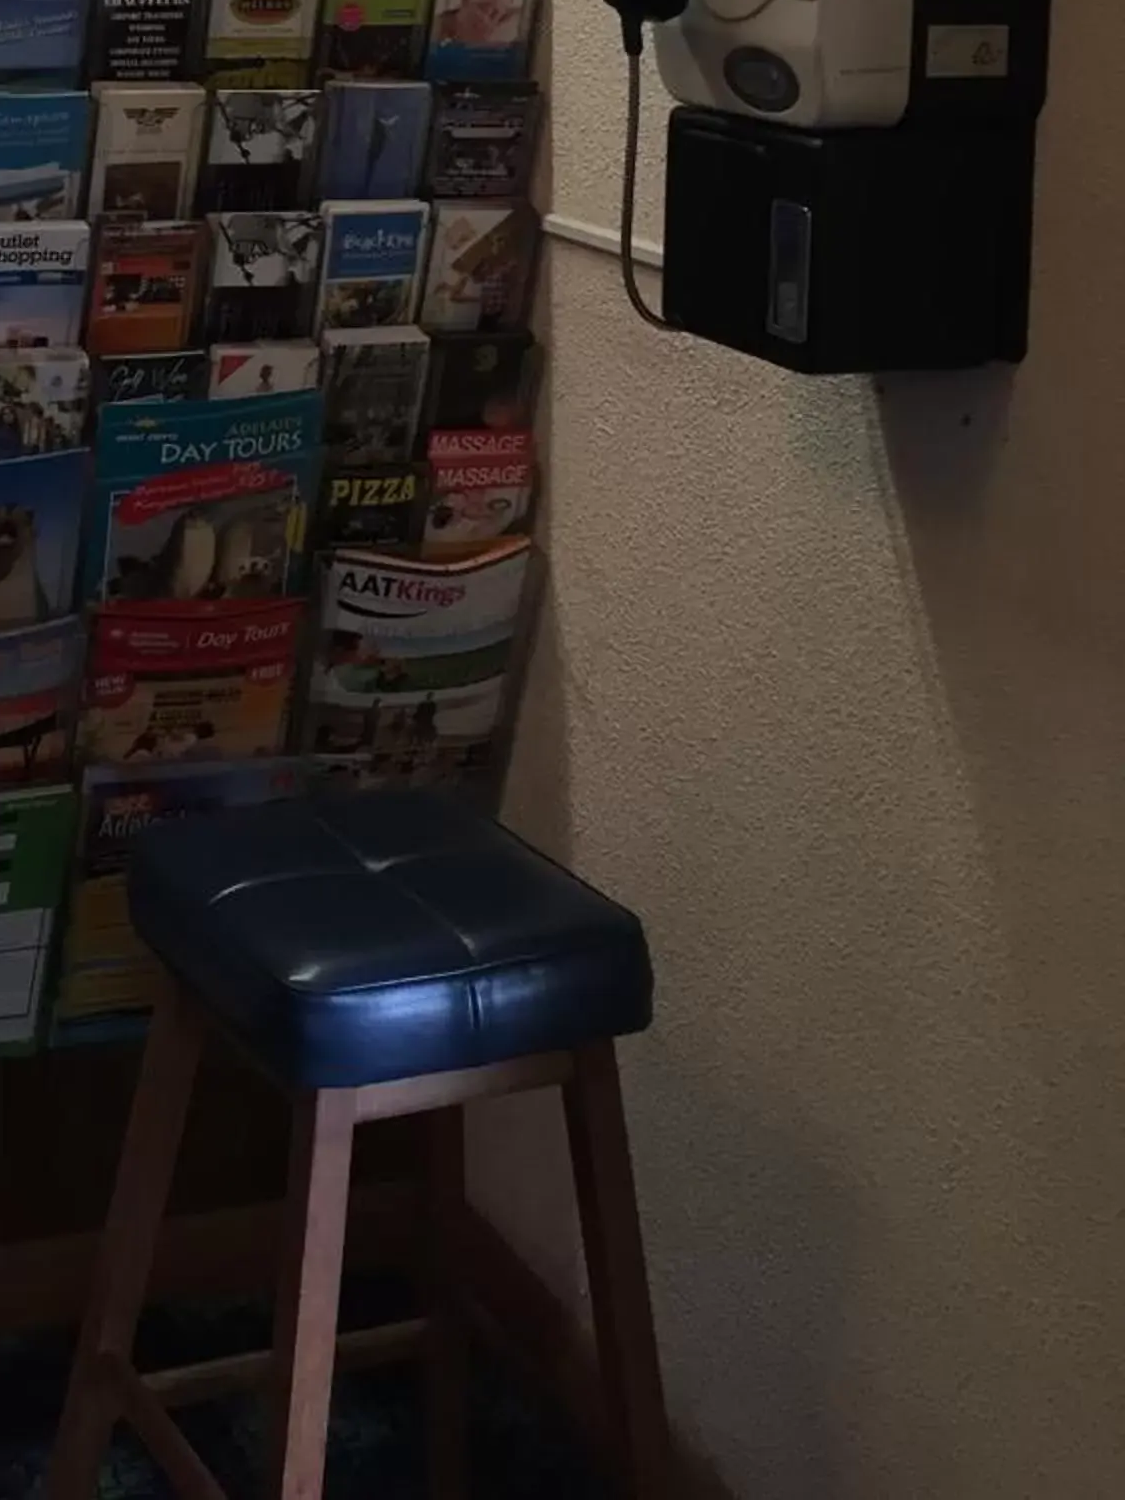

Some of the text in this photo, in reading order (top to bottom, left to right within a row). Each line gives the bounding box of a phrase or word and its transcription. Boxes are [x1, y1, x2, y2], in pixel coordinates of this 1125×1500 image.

[160, 430, 303, 464] DAY TOURS
[431, 435, 525, 455] MASSAGE
[436, 465, 528, 488] MASSAGE
[330, 475, 416, 507] PIZZA
[338, 571, 466, 608] AATKings
[197, 630, 238, 648] Day
